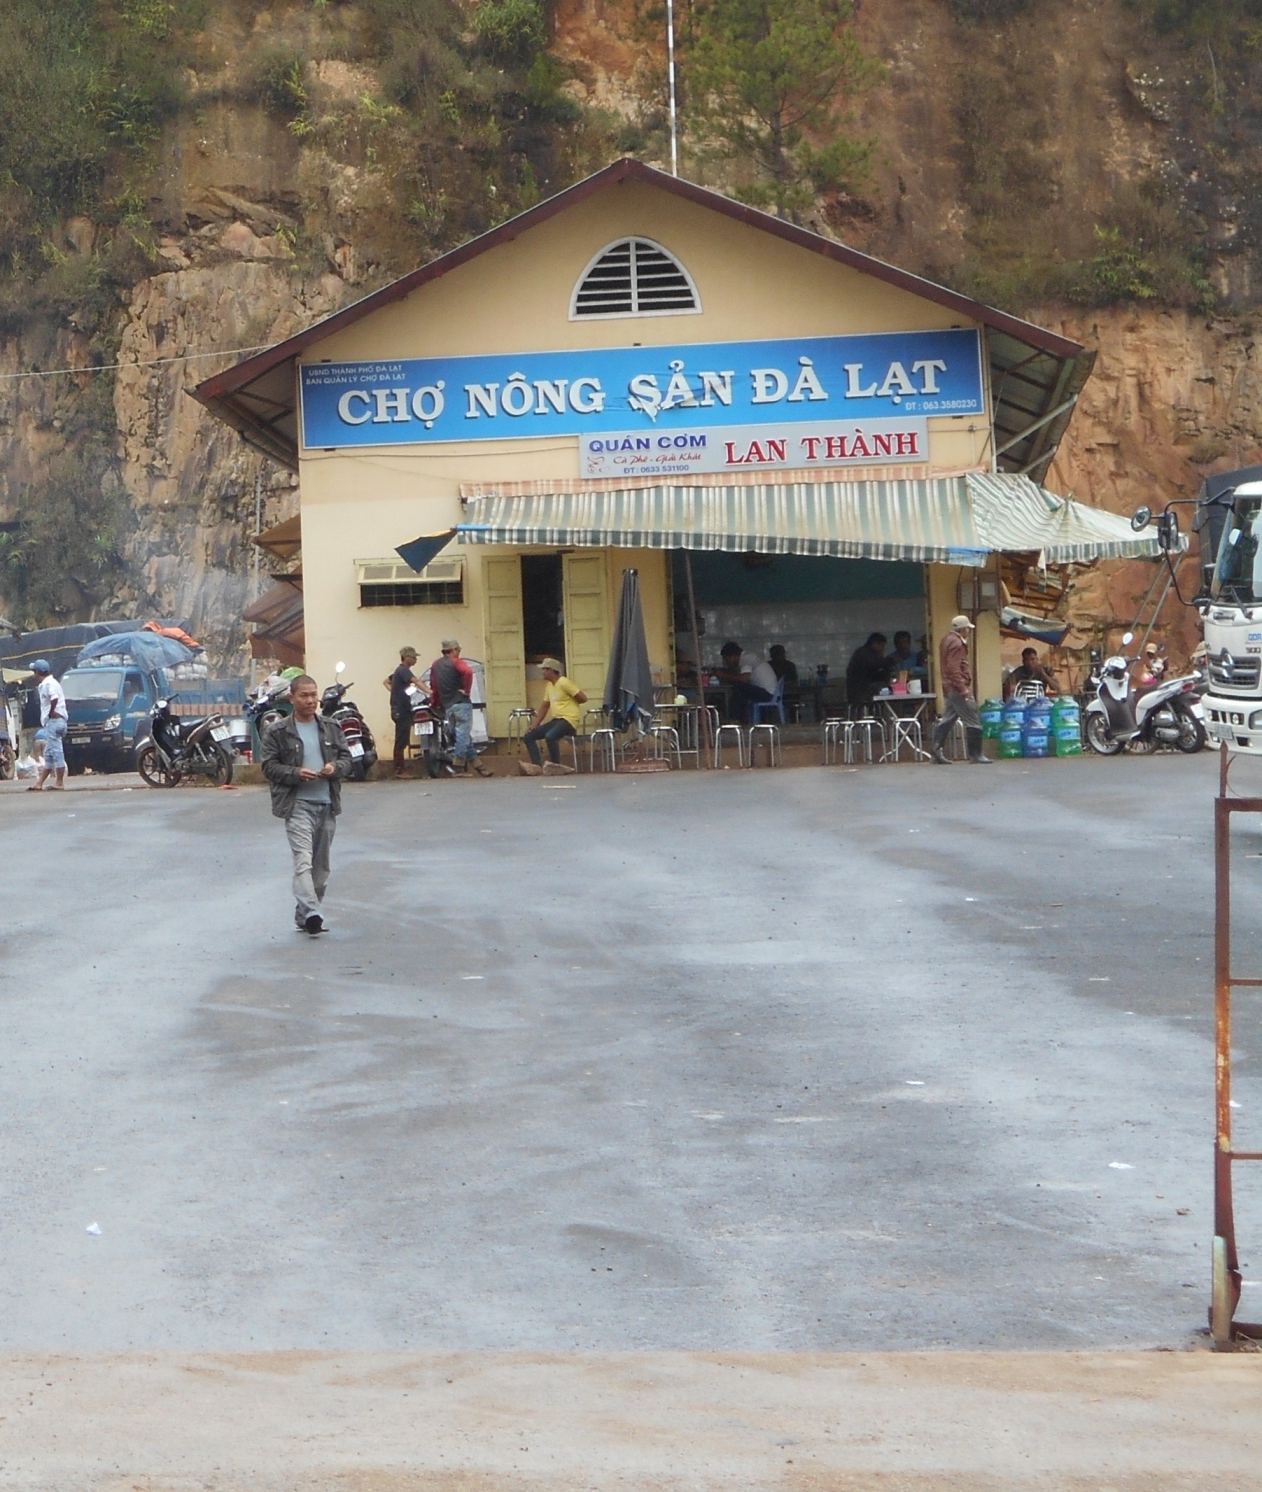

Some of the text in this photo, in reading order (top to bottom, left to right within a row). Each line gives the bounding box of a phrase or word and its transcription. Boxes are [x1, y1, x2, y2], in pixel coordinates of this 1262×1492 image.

[332, 366, 357, 375] THÀNH
[306, 377, 322, 385] BAN
[338, 356, 948, 429] CHỢ NÔNG SẢN ĐÀ LẠT
[589, 433, 707, 452] QUÁN CƠM
[724, 428, 919, 465] LAN THÀNH
[613, 456, 628, 465] Cà
[629, 455, 648, 465] Phê
[679, 453, 702, 461] Khát
[640, 465, 660, 473] 0633
[661, 465, 690, 473] 531100
